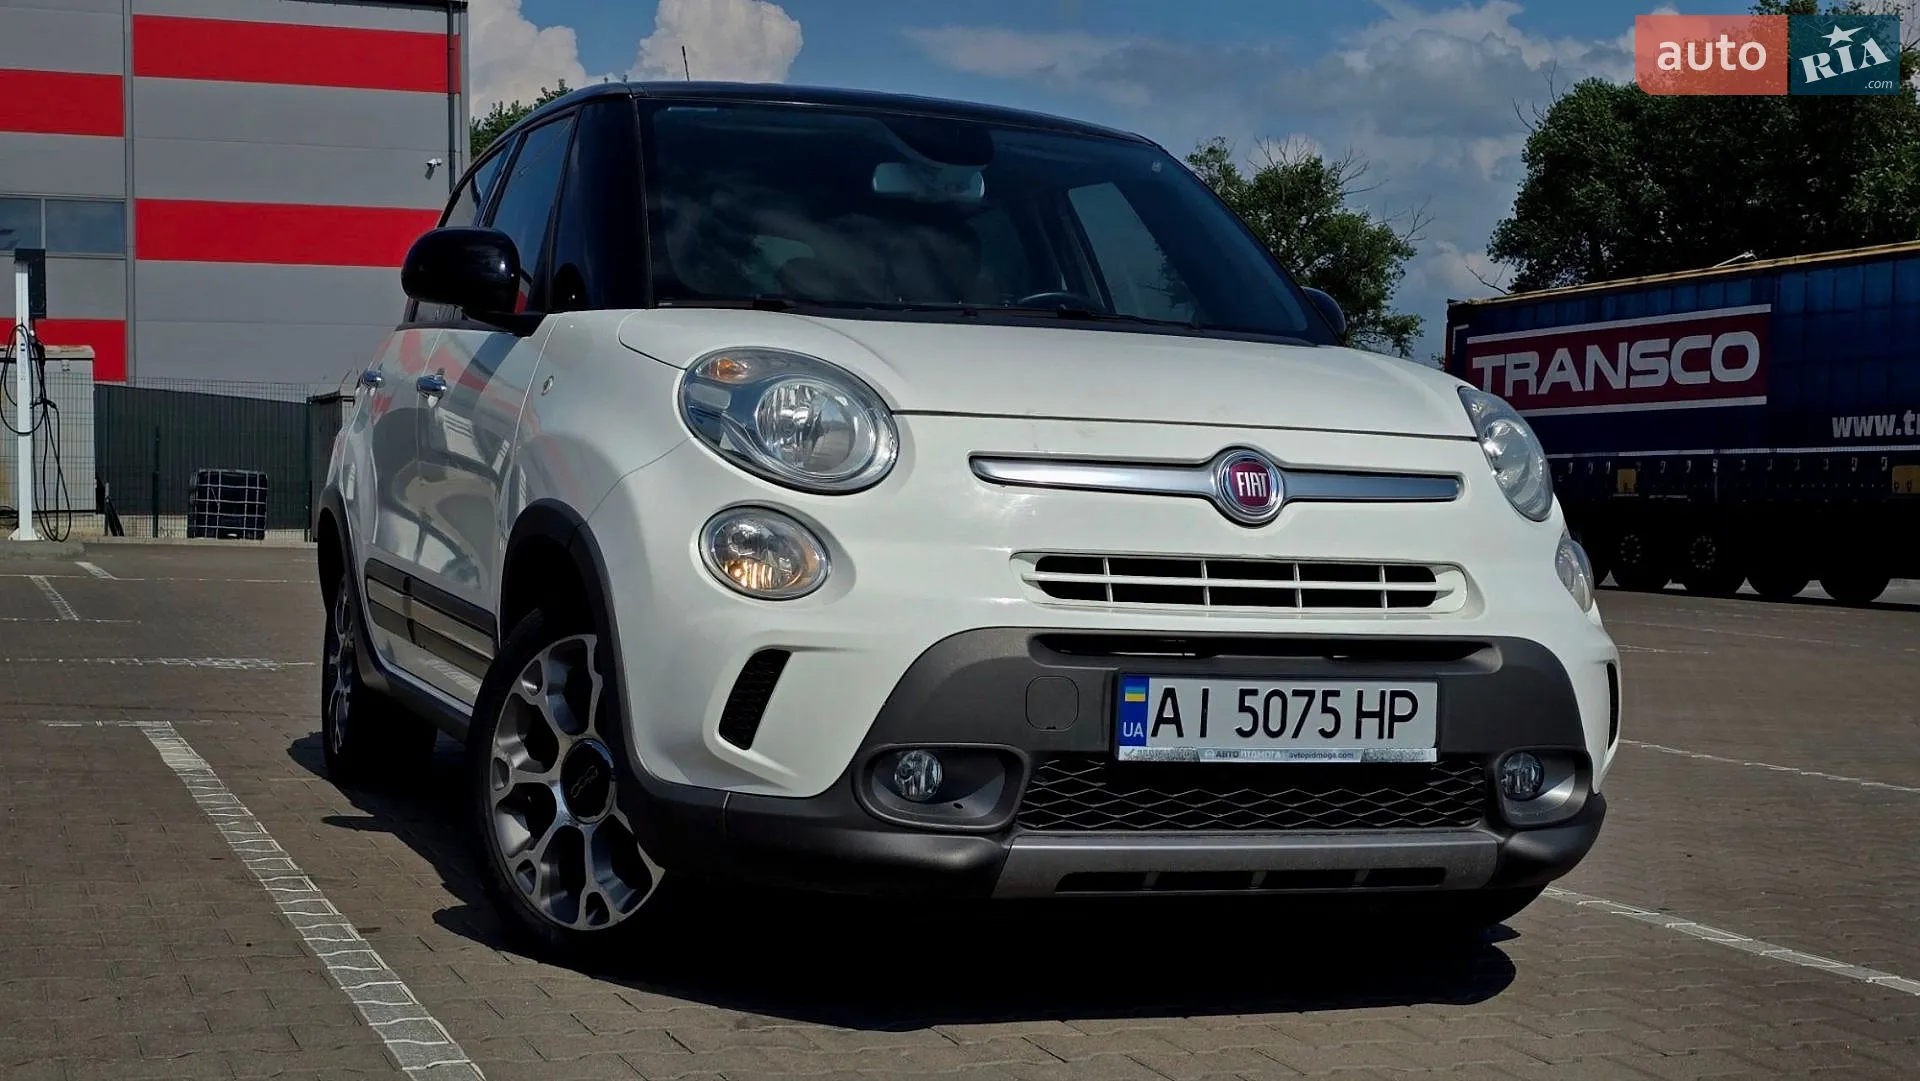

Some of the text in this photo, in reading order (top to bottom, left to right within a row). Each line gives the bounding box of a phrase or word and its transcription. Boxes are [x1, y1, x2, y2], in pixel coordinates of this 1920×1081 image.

[1472, 331, 1760, 397] TRANSCO
[1236, 471, 1267, 497] FIAT
[1122, 721, 1144, 738] UA
[1151, 687, 1419, 740] AI 5075 HP
